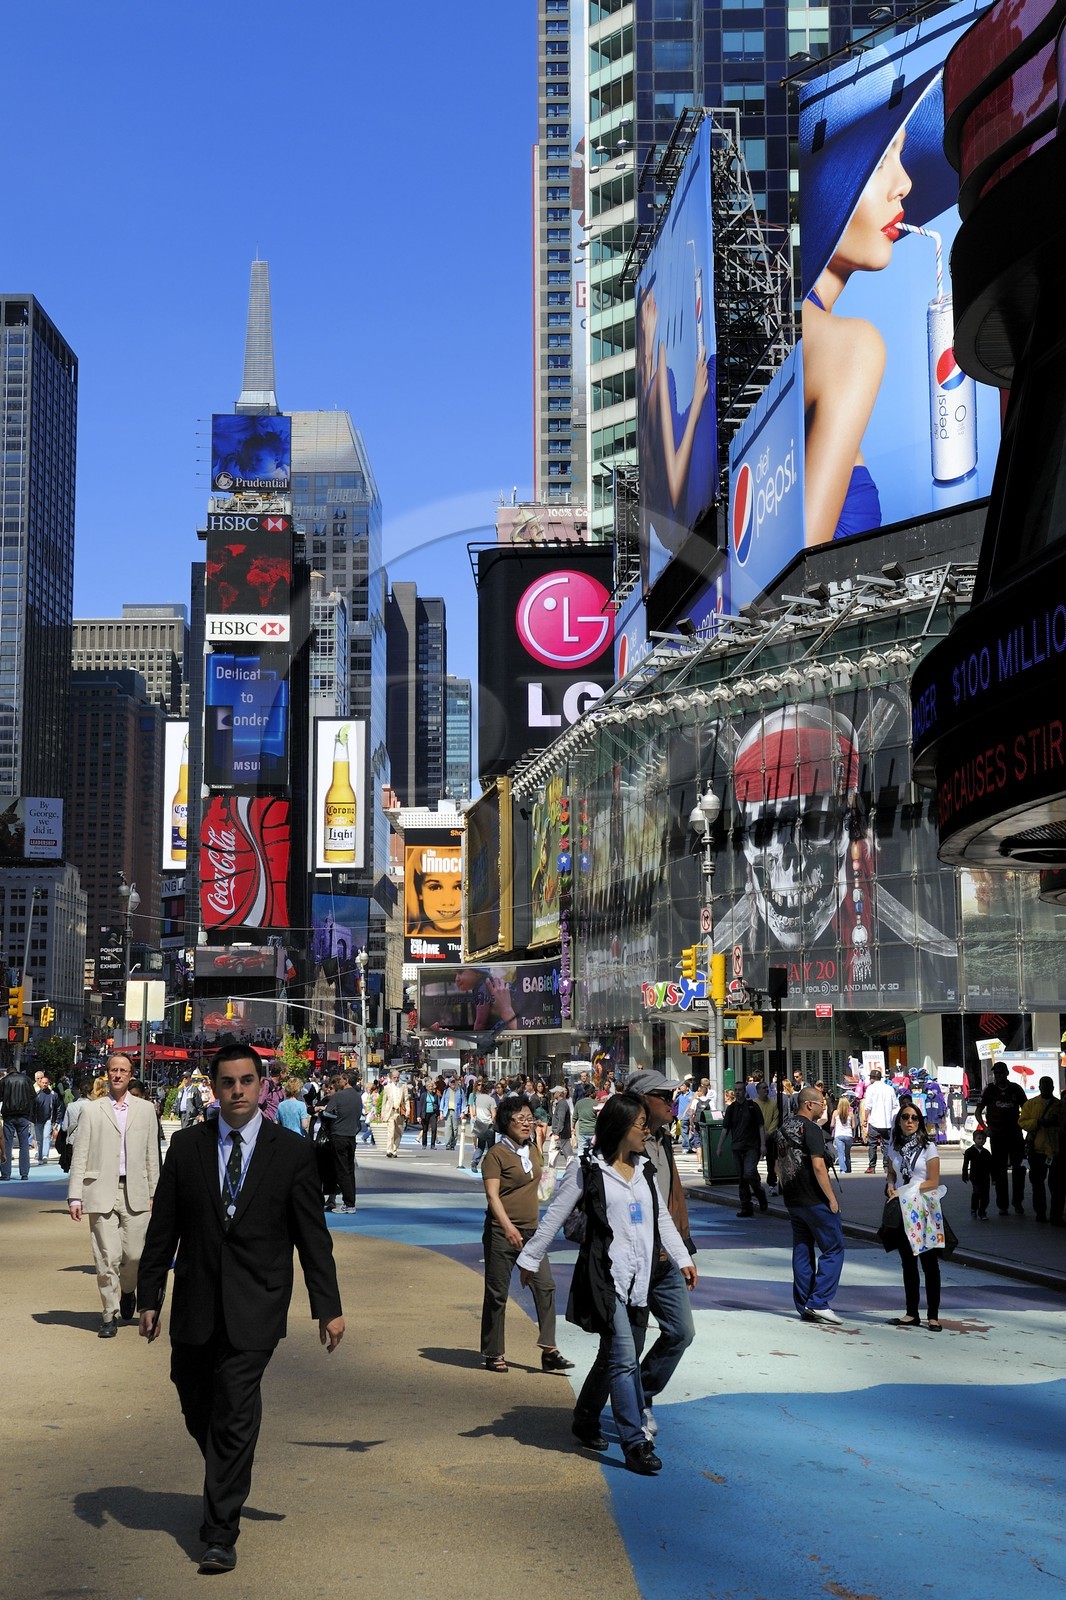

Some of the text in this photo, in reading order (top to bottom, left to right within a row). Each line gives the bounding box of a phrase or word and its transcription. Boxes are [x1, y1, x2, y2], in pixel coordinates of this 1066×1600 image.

[937, 394, 949, 440] pepsi
[755, 446, 770, 484] diet
[235, 477, 288, 488] Prudential
[756, 438, 796, 539] pepsi
[547, 508, 572, 517] 100%
[209, 516, 259, 532] HSBC
[210, 621, 258, 636] HSBC
[952, 646, 991, 706] $100
[240, 691, 254, 704] to
[954, 744, 1008, 812] CAUSES
[1014, 719, 1065, 782] STIR
[40, 801, 50, 810] By
[29, 809, 59, 819] George,
[32, 826, 46, 834] did
[328, 827, 353, 841] Light
[427, 849, 437, 857] the
[816, 960, 836, 981] 20
[843, 983, 861, 992] AND
[861, 982, 886, 991] IMAX
[887, 982, 900, 991] 3D
[641, 981, 678, 1010] TOYS
[424, 1037, 448, 1048] swatch
